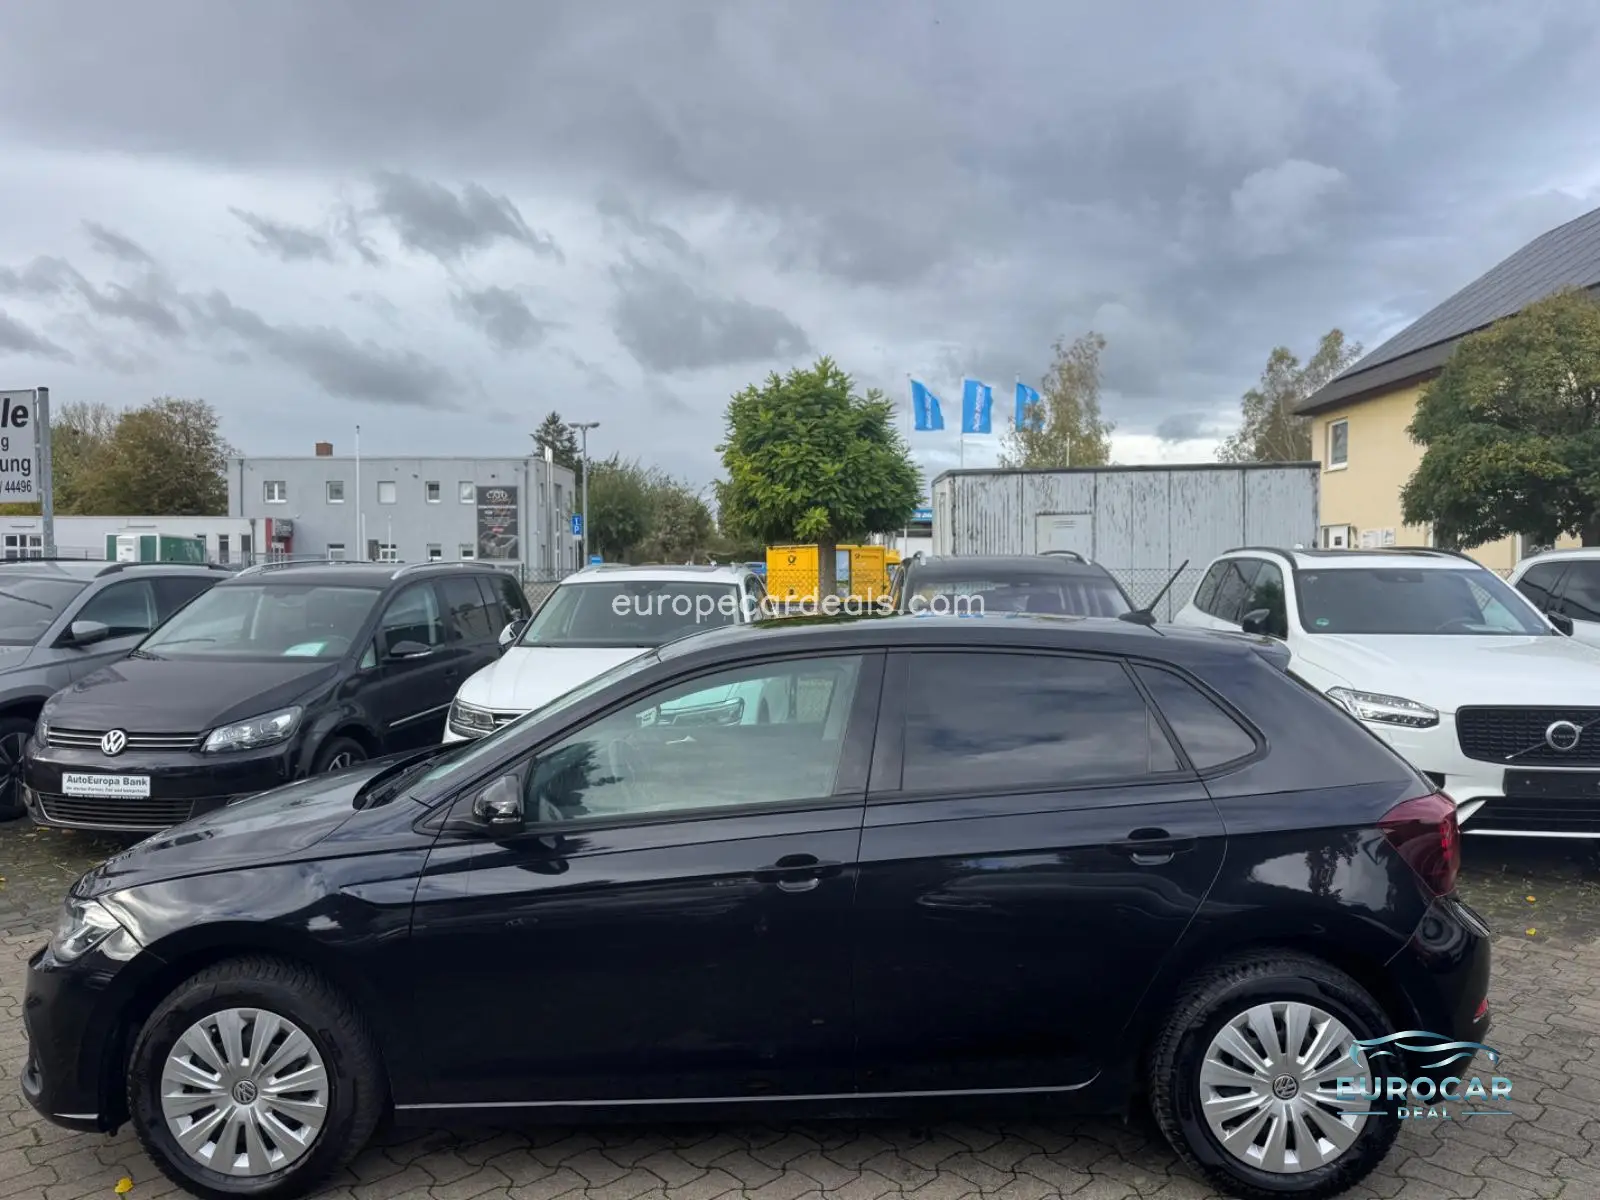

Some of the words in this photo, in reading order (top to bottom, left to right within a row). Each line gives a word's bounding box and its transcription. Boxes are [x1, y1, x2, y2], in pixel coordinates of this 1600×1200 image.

[5, 480, 32, 493] 44496
[66, 775, 120, 786] AutoEuropa
[123, 777, 147, 786] Bank
